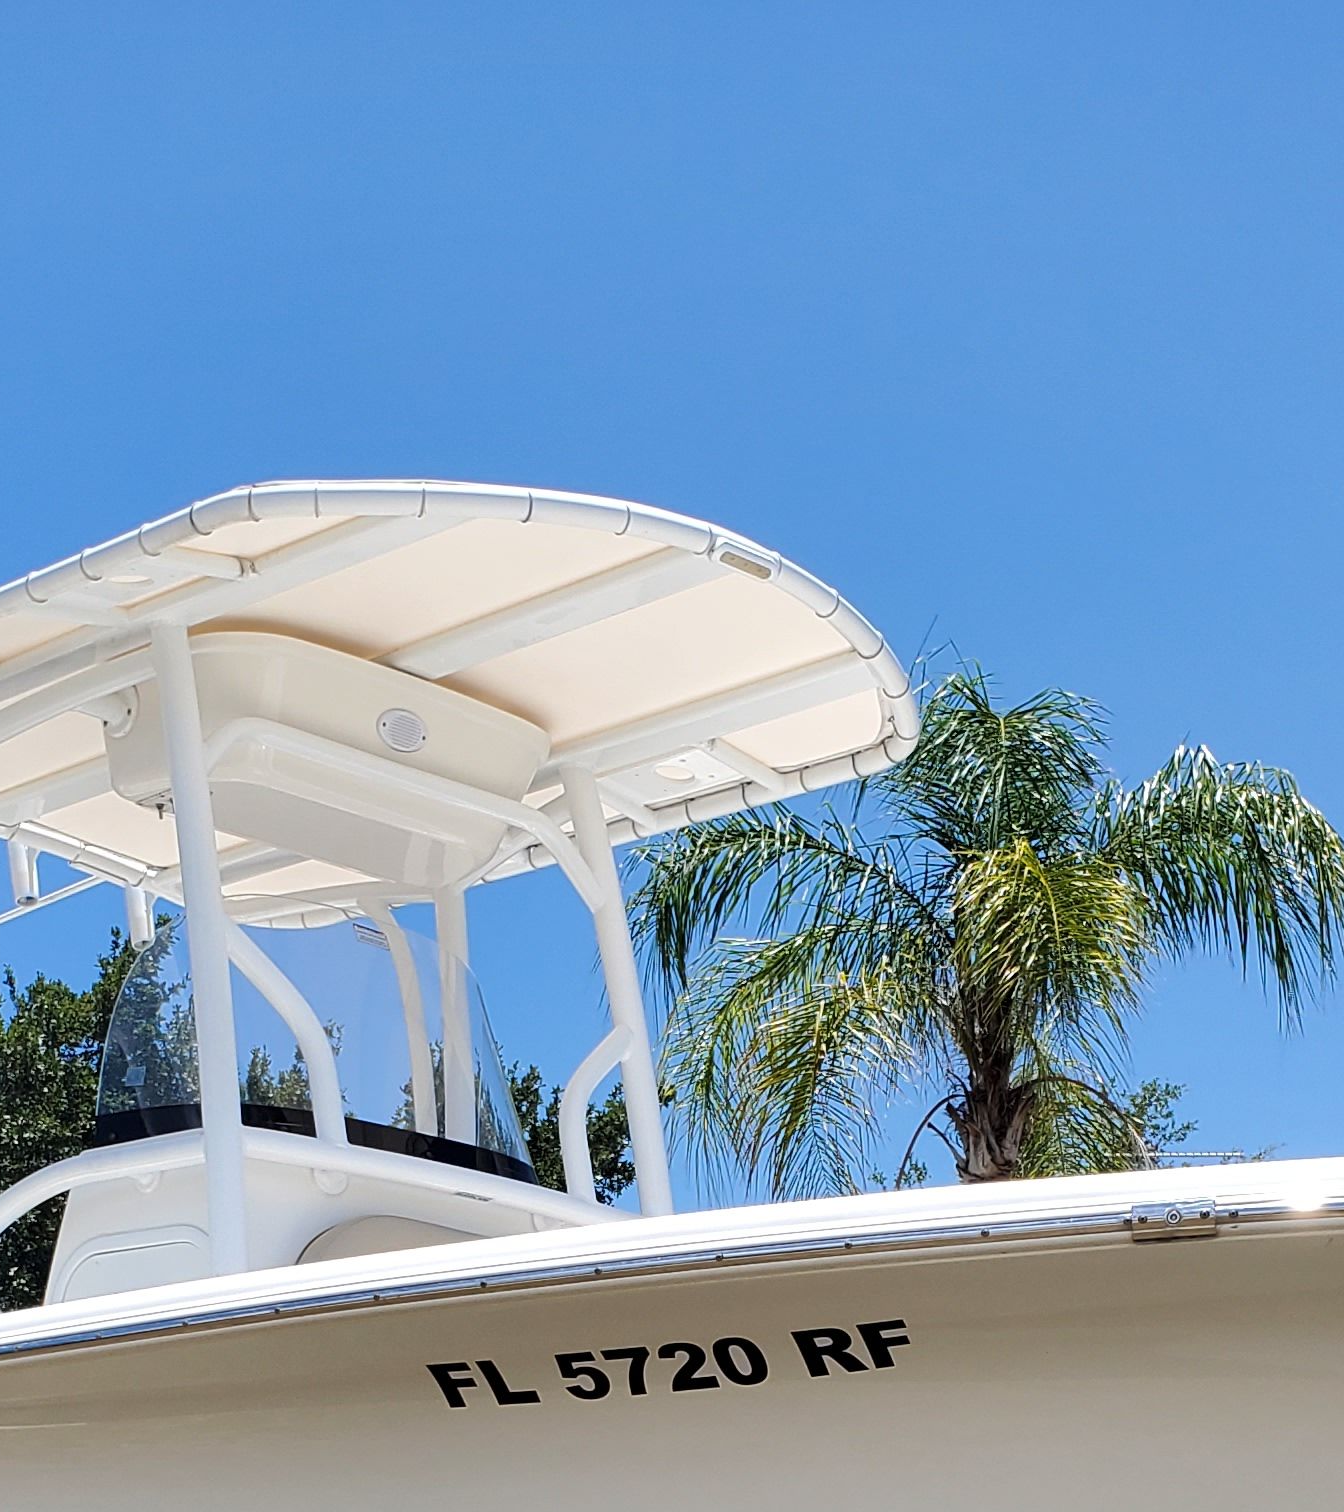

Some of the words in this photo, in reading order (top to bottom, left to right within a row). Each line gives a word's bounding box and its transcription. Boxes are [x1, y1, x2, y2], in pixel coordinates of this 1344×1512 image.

[426, 1359, 542, 1409] FL
[554, 1336, 770, 1401] 5720
[790, 1318, 912, 1379] RF
